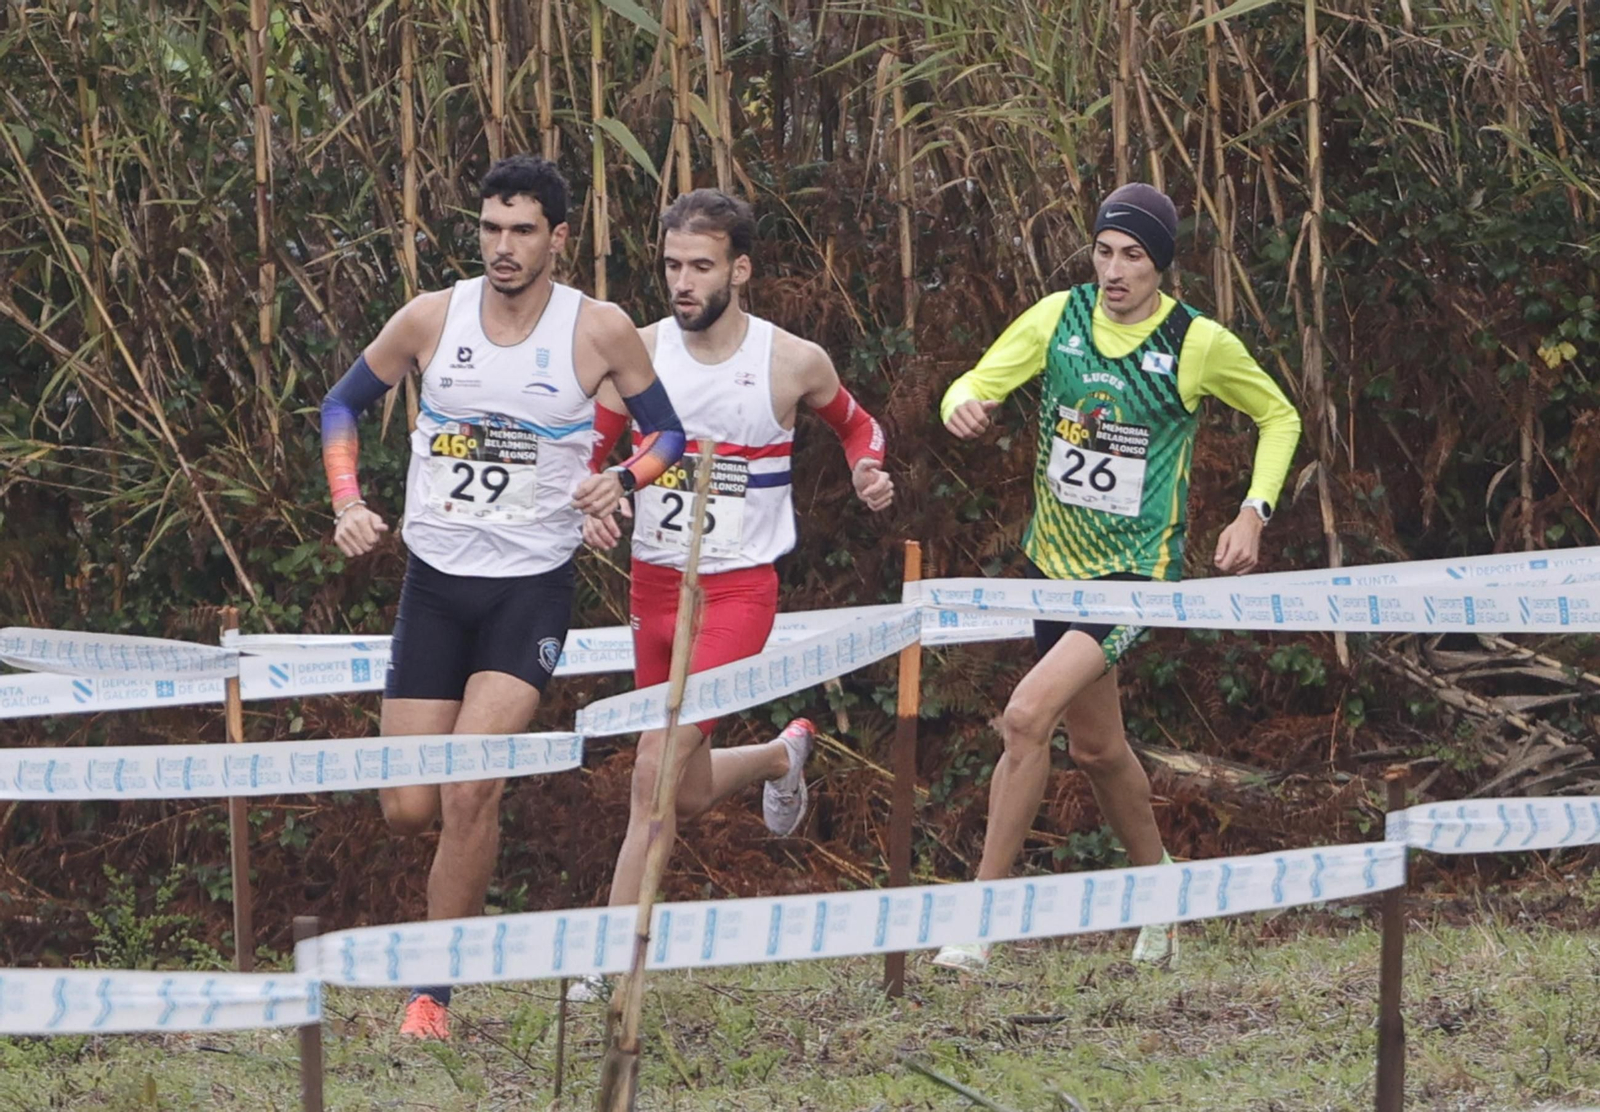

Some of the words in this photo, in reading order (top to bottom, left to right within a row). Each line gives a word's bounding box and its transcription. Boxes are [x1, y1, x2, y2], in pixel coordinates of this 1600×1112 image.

[1082, 372, 1126, 391] LUCUS
[490, 429, 537, 440] MEMORIAL
[1102, 422, 1149, 437] MEMORIAL
[484, 438, 537, 450] BELARMINO
[1096, 431, 1149, 446] BELARMINO
[499, 449, 536, 460] ALONSO
[1109, 443, 1146, 455] ALONSO
[712, 462, 749, 473] MORIAL
[1061, 448, 1117, 492] 26
[693, 470, 749, 483] BARMINO
[450, 462, 510, 504] 29
[660, 492, 716, 535] 25
[1356, 574, 1398, 586] XUNTA
[571, 653, 586, 664] DE
[299, 660, 348, 673] DEPORTE
[301, 674, 345, 686] GALEGO
[103, 688, 149, 700] GALEGO
[2, 696, 50, 707] GALICIA
